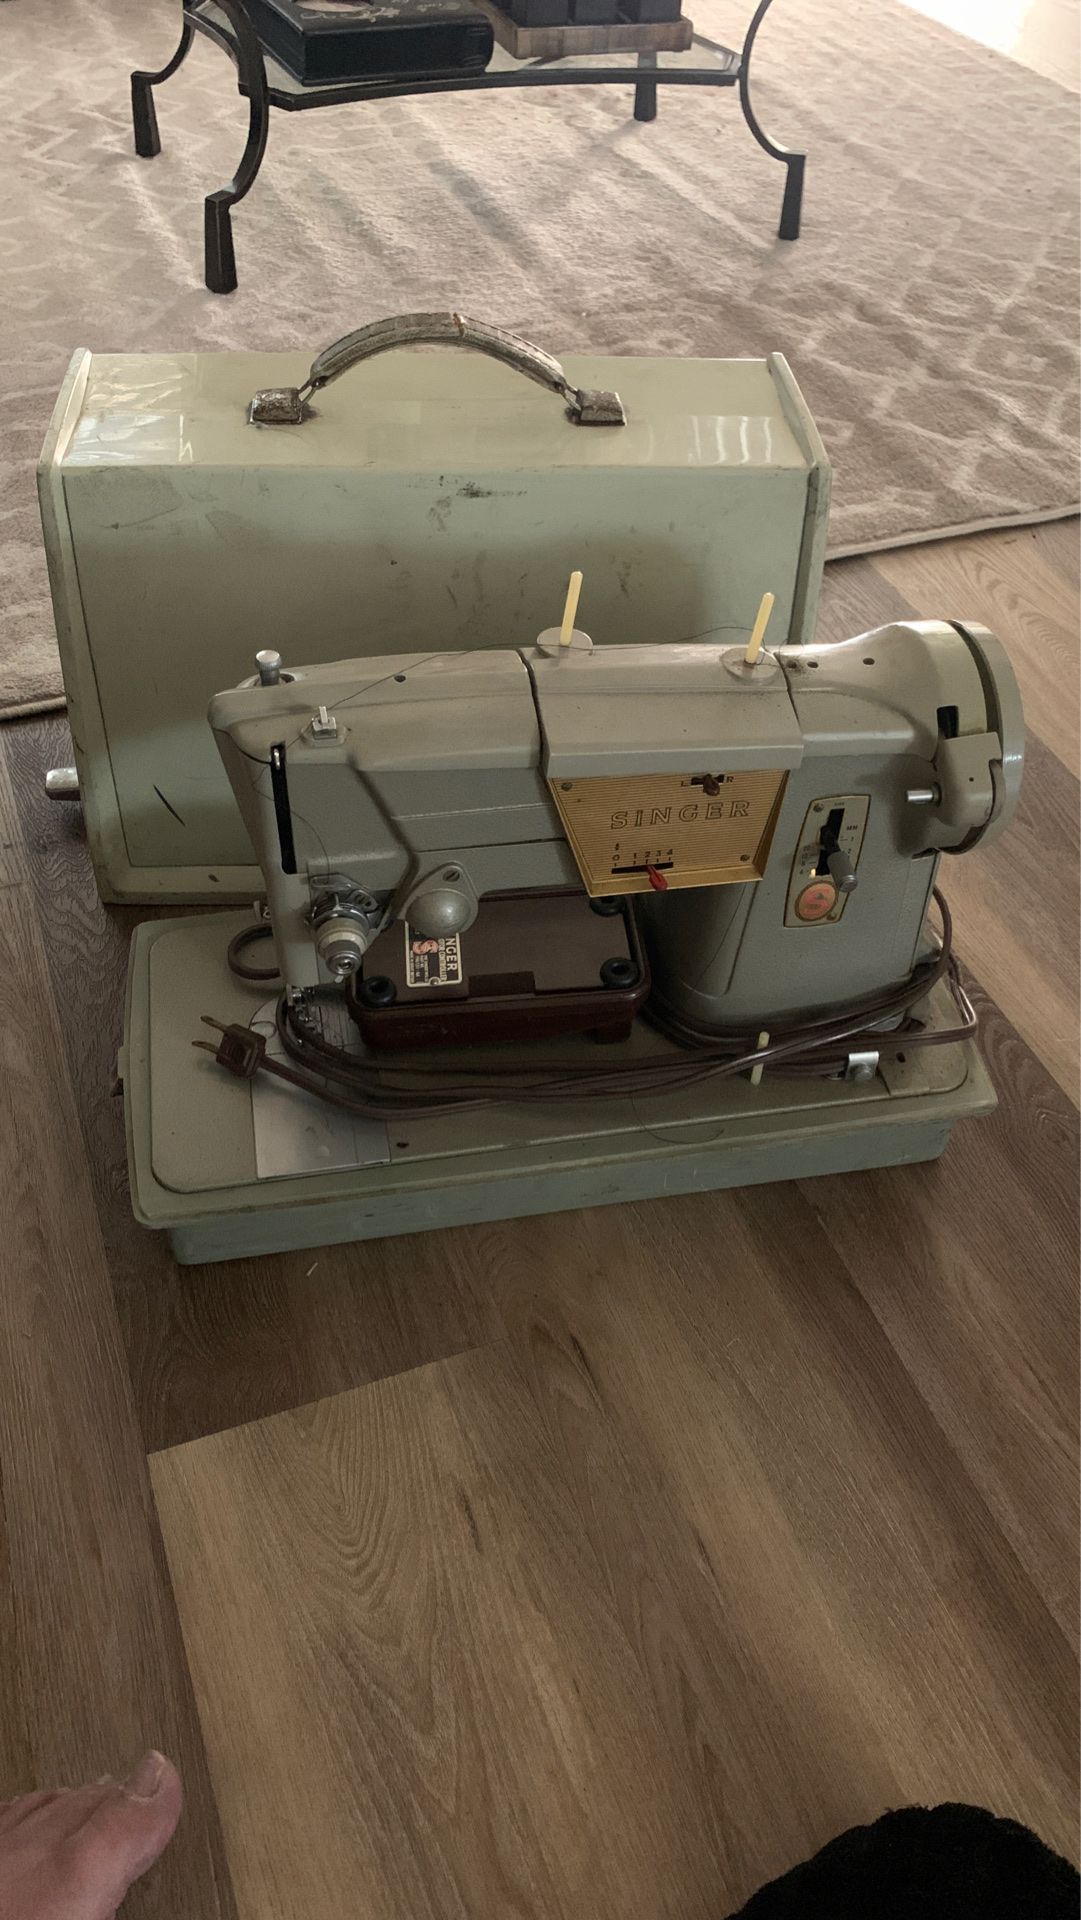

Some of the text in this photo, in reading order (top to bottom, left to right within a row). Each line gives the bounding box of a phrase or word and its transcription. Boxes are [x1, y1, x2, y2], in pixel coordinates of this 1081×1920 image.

[726, 775, 734, 783] R
[610, 800, 750, 830] SINGER
[656, 849, 662, 857] 3
[666, 848, 673, 856] 4
[445, 938, 458, 971] NGER
